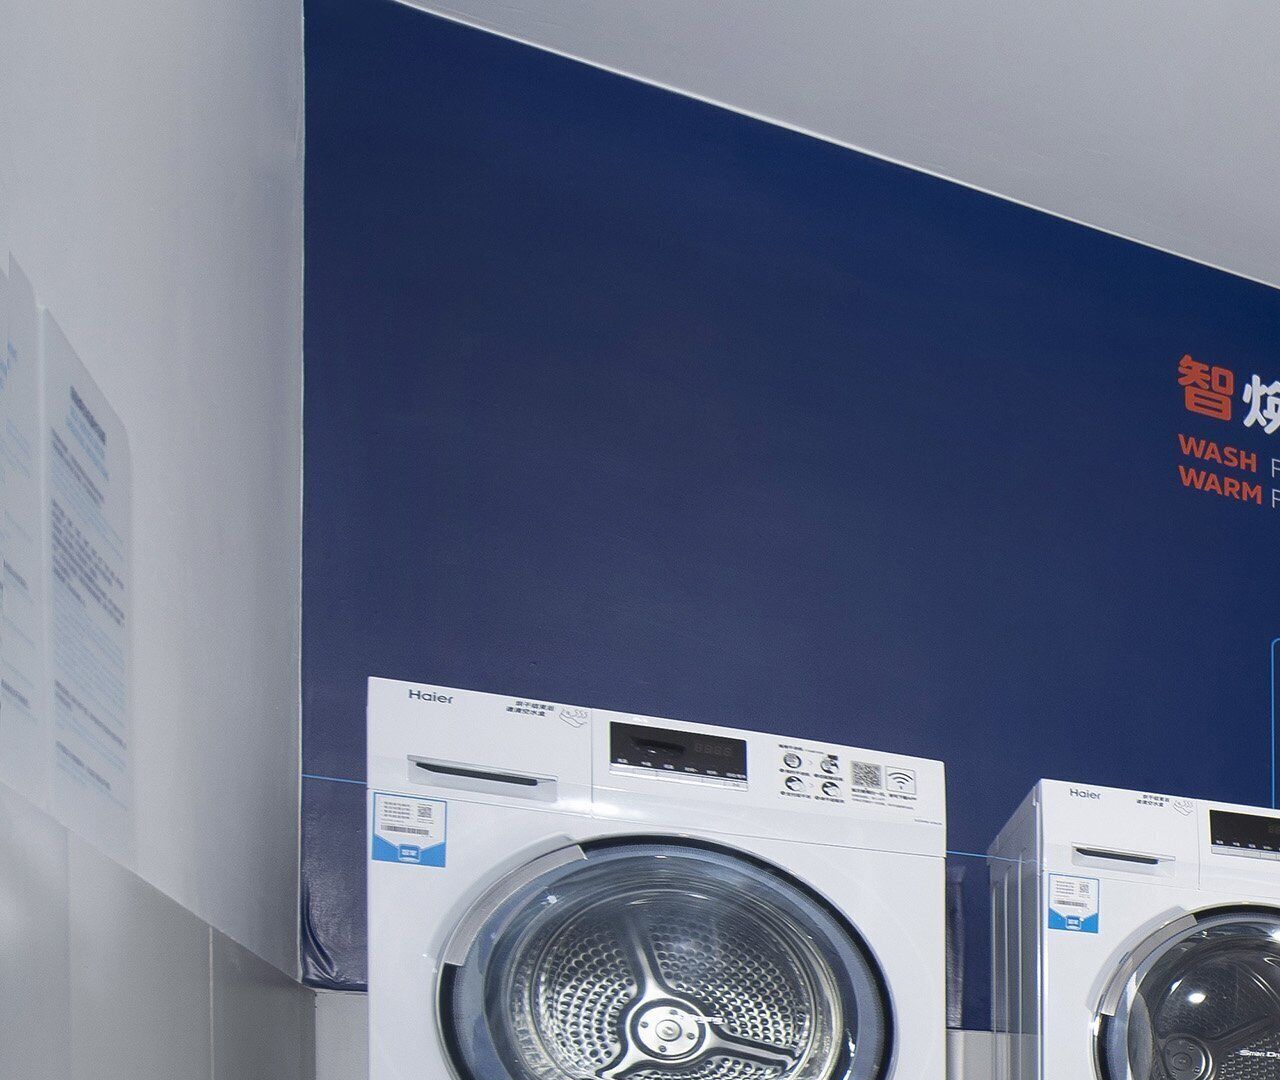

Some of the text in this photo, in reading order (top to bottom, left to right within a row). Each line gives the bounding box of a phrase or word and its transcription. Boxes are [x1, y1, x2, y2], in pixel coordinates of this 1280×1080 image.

[1177, 433, 1258, 473] WASH
[1177, 465, 1262, 505] WARM
[409, 689, 453, 704] Haier
[1070, 788, 1101, 799] Haier
